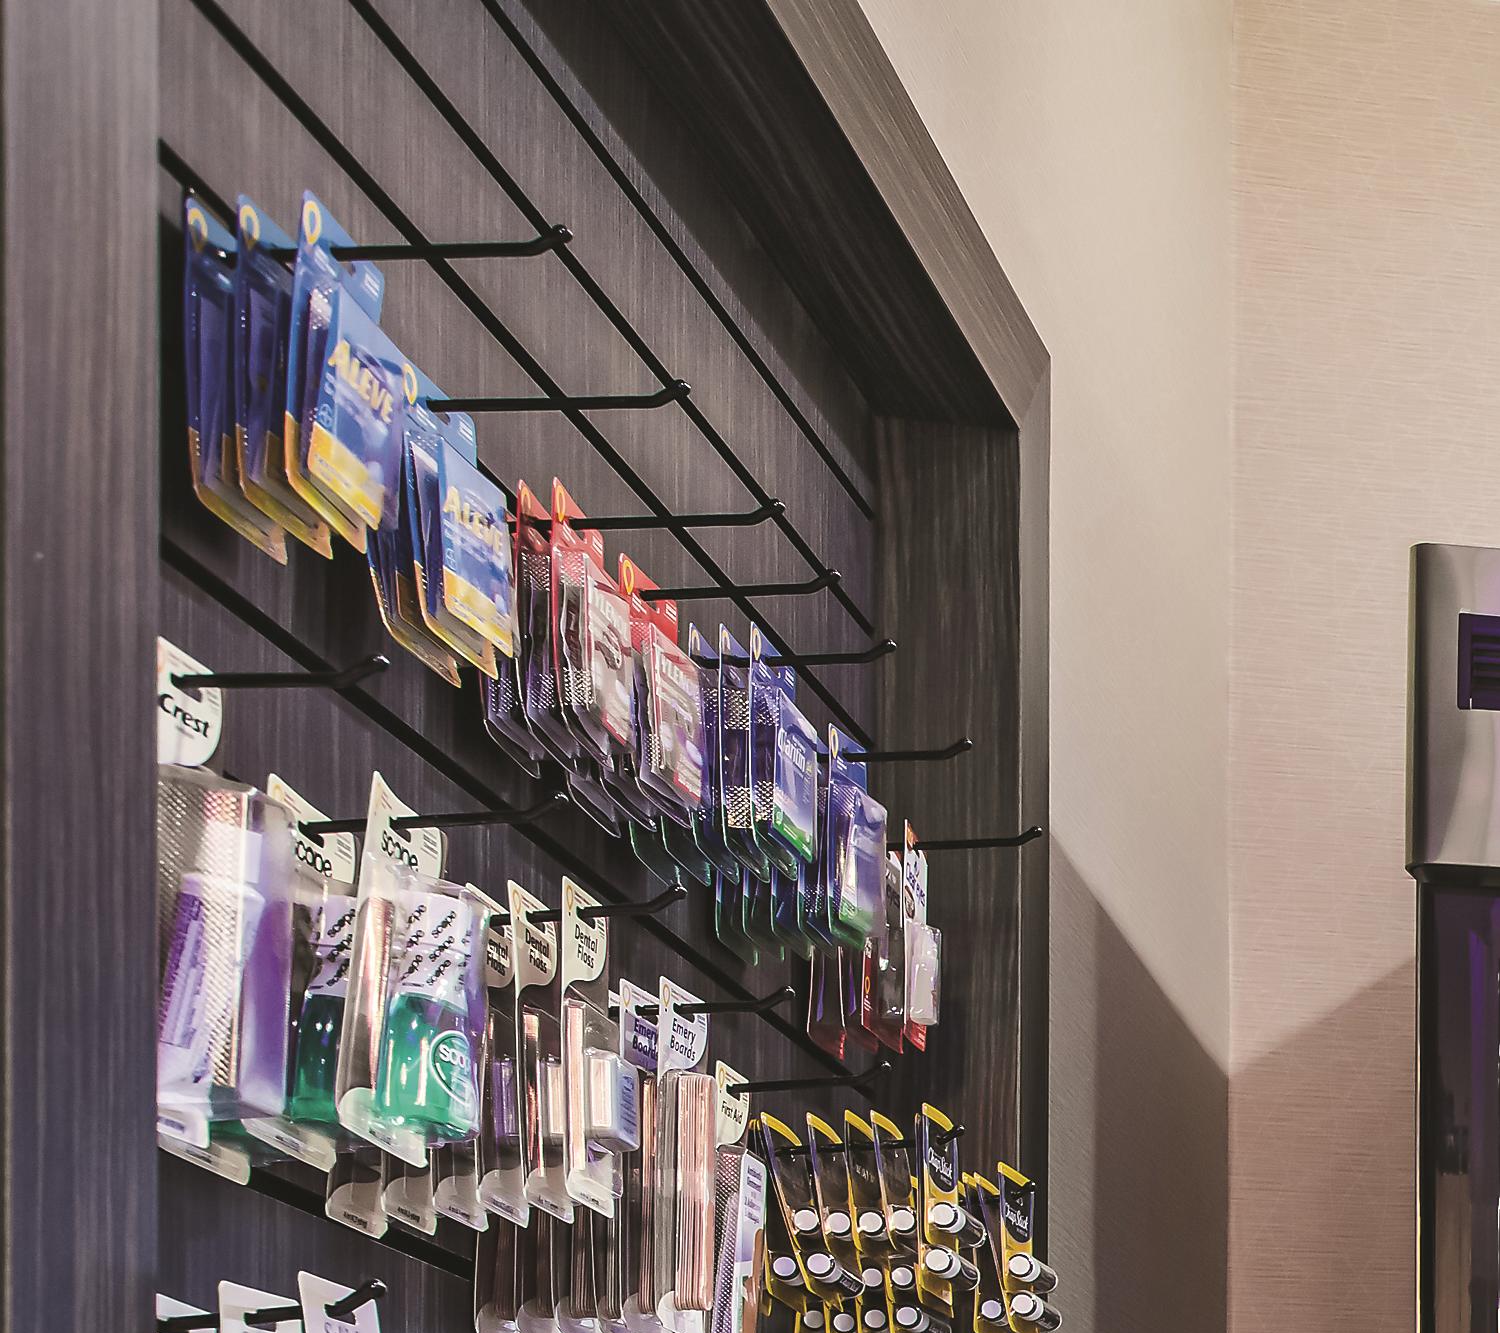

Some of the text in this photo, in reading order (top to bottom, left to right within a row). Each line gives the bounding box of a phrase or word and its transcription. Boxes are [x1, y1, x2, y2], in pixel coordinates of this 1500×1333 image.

[328, 339, 395, 425] ALEVE
[443, 485, 506, 563] ALEVE
[160, 692, 211, 739] Crest
[431, 909, 458, 939] scope
[574, 924, 599, 952] Dental
[524, 928, 551, 959] Dental
[528, 950, 548, 974] Floss
[577, 946, 595, 970] Floss
[672, 1018, 697, 1045] Emery
[670, 1035, 697, 1062] Boards
[721, 1101, 744, 1124] First Aid
